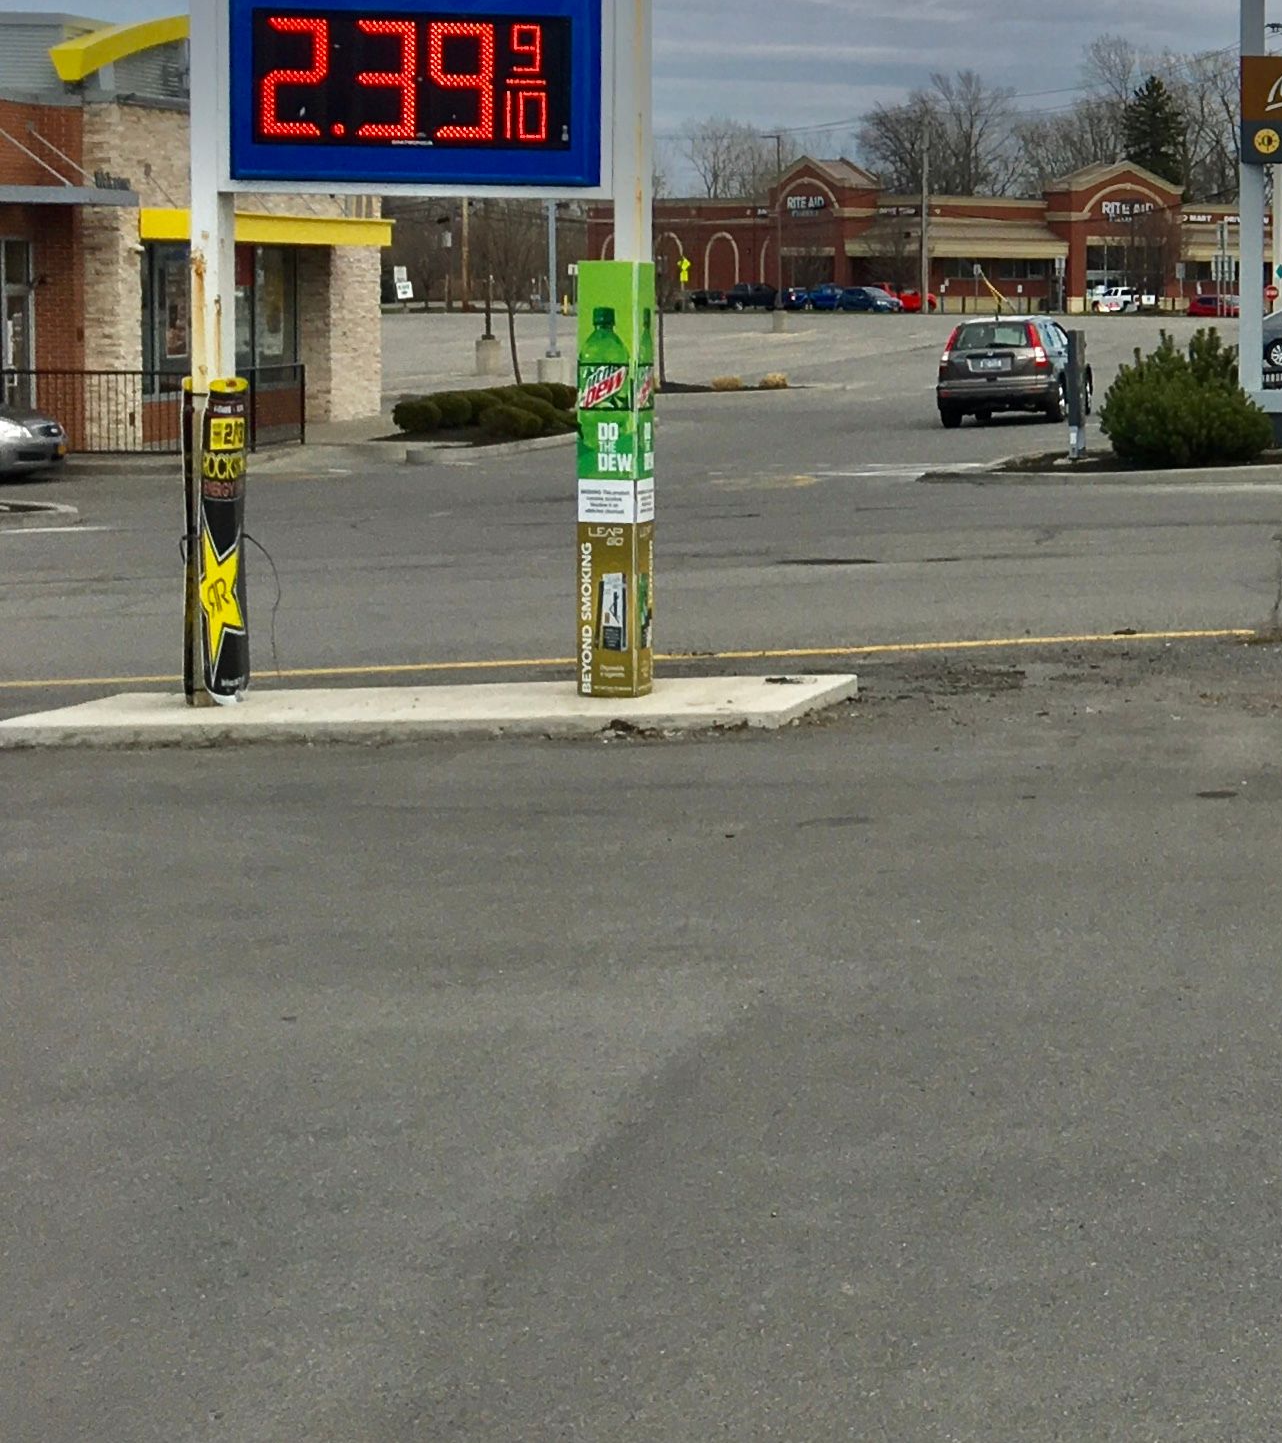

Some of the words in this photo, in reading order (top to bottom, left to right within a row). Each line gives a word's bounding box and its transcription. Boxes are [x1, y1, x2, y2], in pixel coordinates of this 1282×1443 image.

[261, 16, 494, 139] 2.39
[787, 196, 807, 208] RITE
[808, 196, 825, 208] AID
[1102, 201, 1130, 215] RITE
[597, 422, 619, 441] DO
[599, 440, 617, 453] THE
[597, 452, 633, 472] DEW
[581, 542, 592, 621] SMOKING
[581, 625, 592, 694] BEYOND
